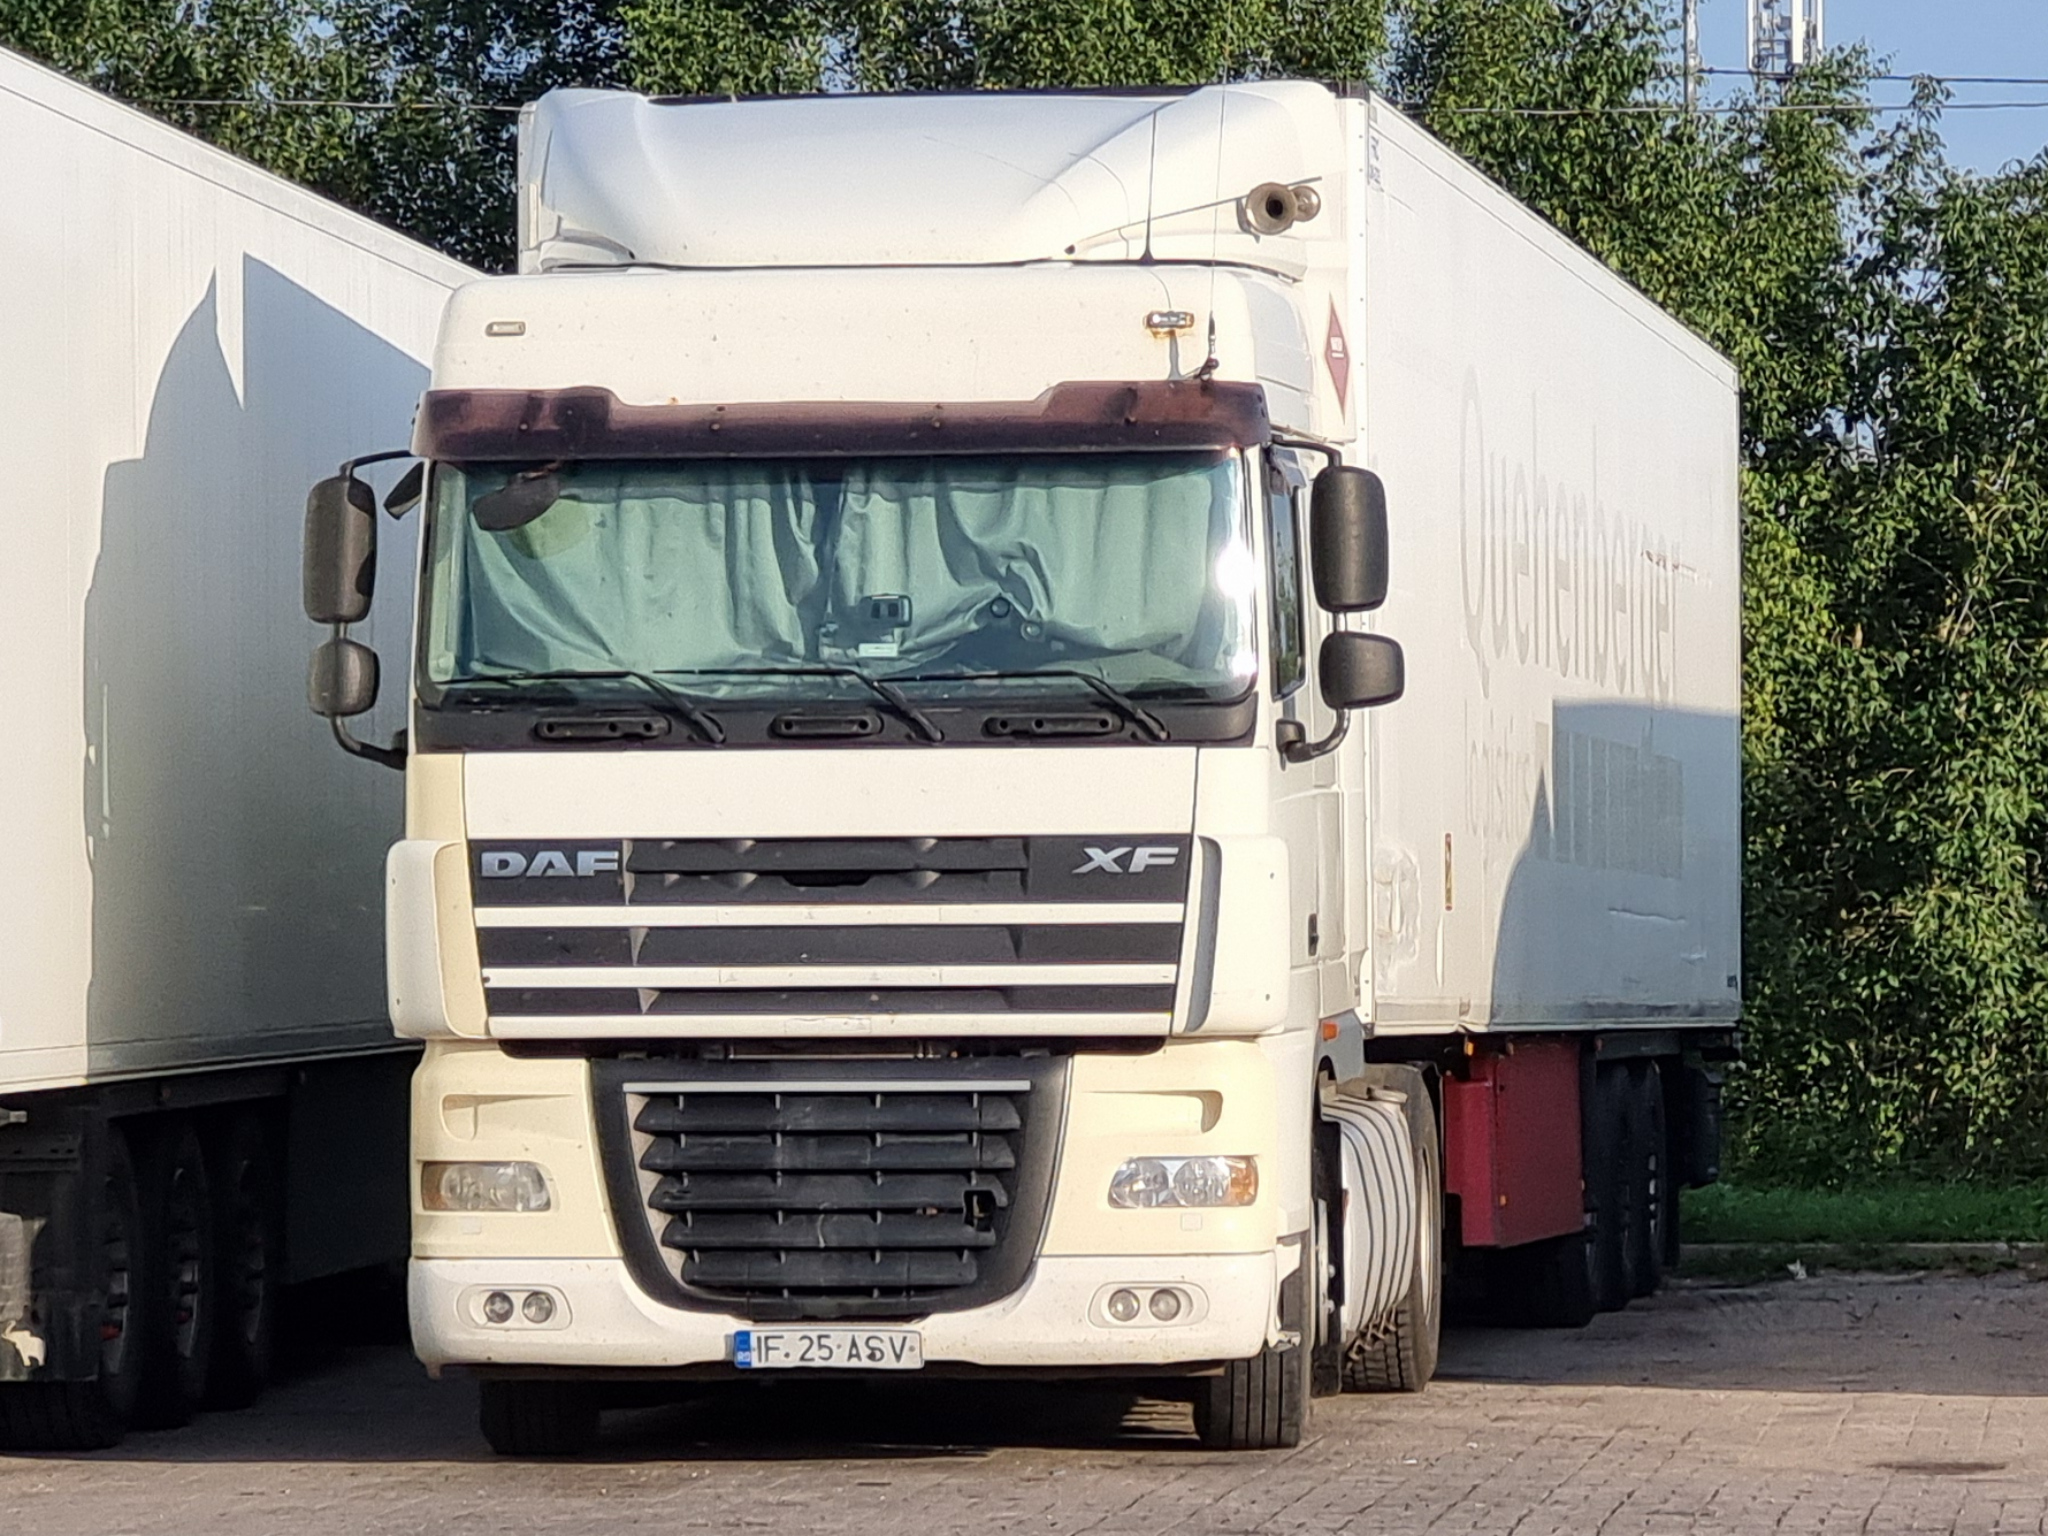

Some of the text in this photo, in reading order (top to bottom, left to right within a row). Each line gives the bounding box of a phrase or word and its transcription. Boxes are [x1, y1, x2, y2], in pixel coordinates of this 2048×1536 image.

[481, 850, 619, 877] DAF
[1071, 846, 1179, 873] XF
[756, 1334, 907, 1363] IF 25 ASV
